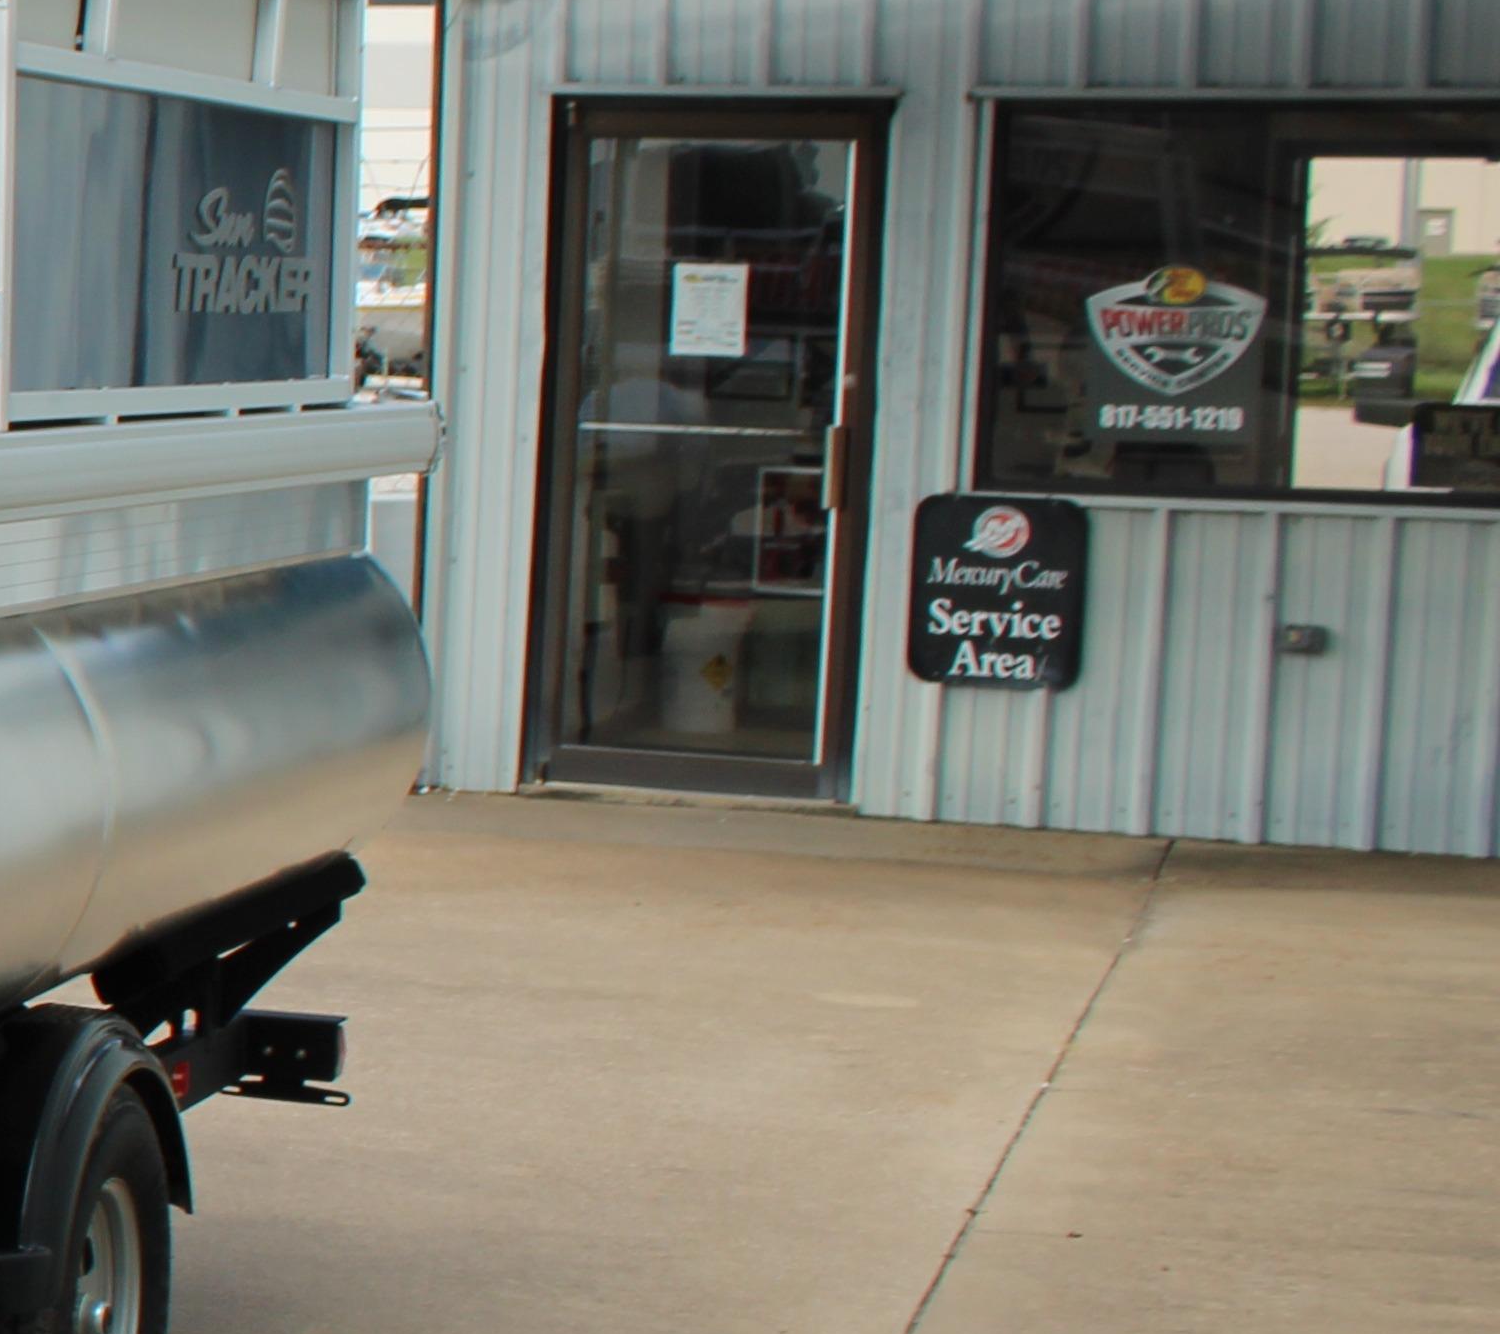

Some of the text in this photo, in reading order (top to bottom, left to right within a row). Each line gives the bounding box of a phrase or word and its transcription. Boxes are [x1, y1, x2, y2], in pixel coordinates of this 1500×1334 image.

[188, 185, 255, 248] Sun
[172, 252, 316, 315] TRACKER
[927, 597, 1063, 641] Service
[947, 639, 1037, 680] Area
